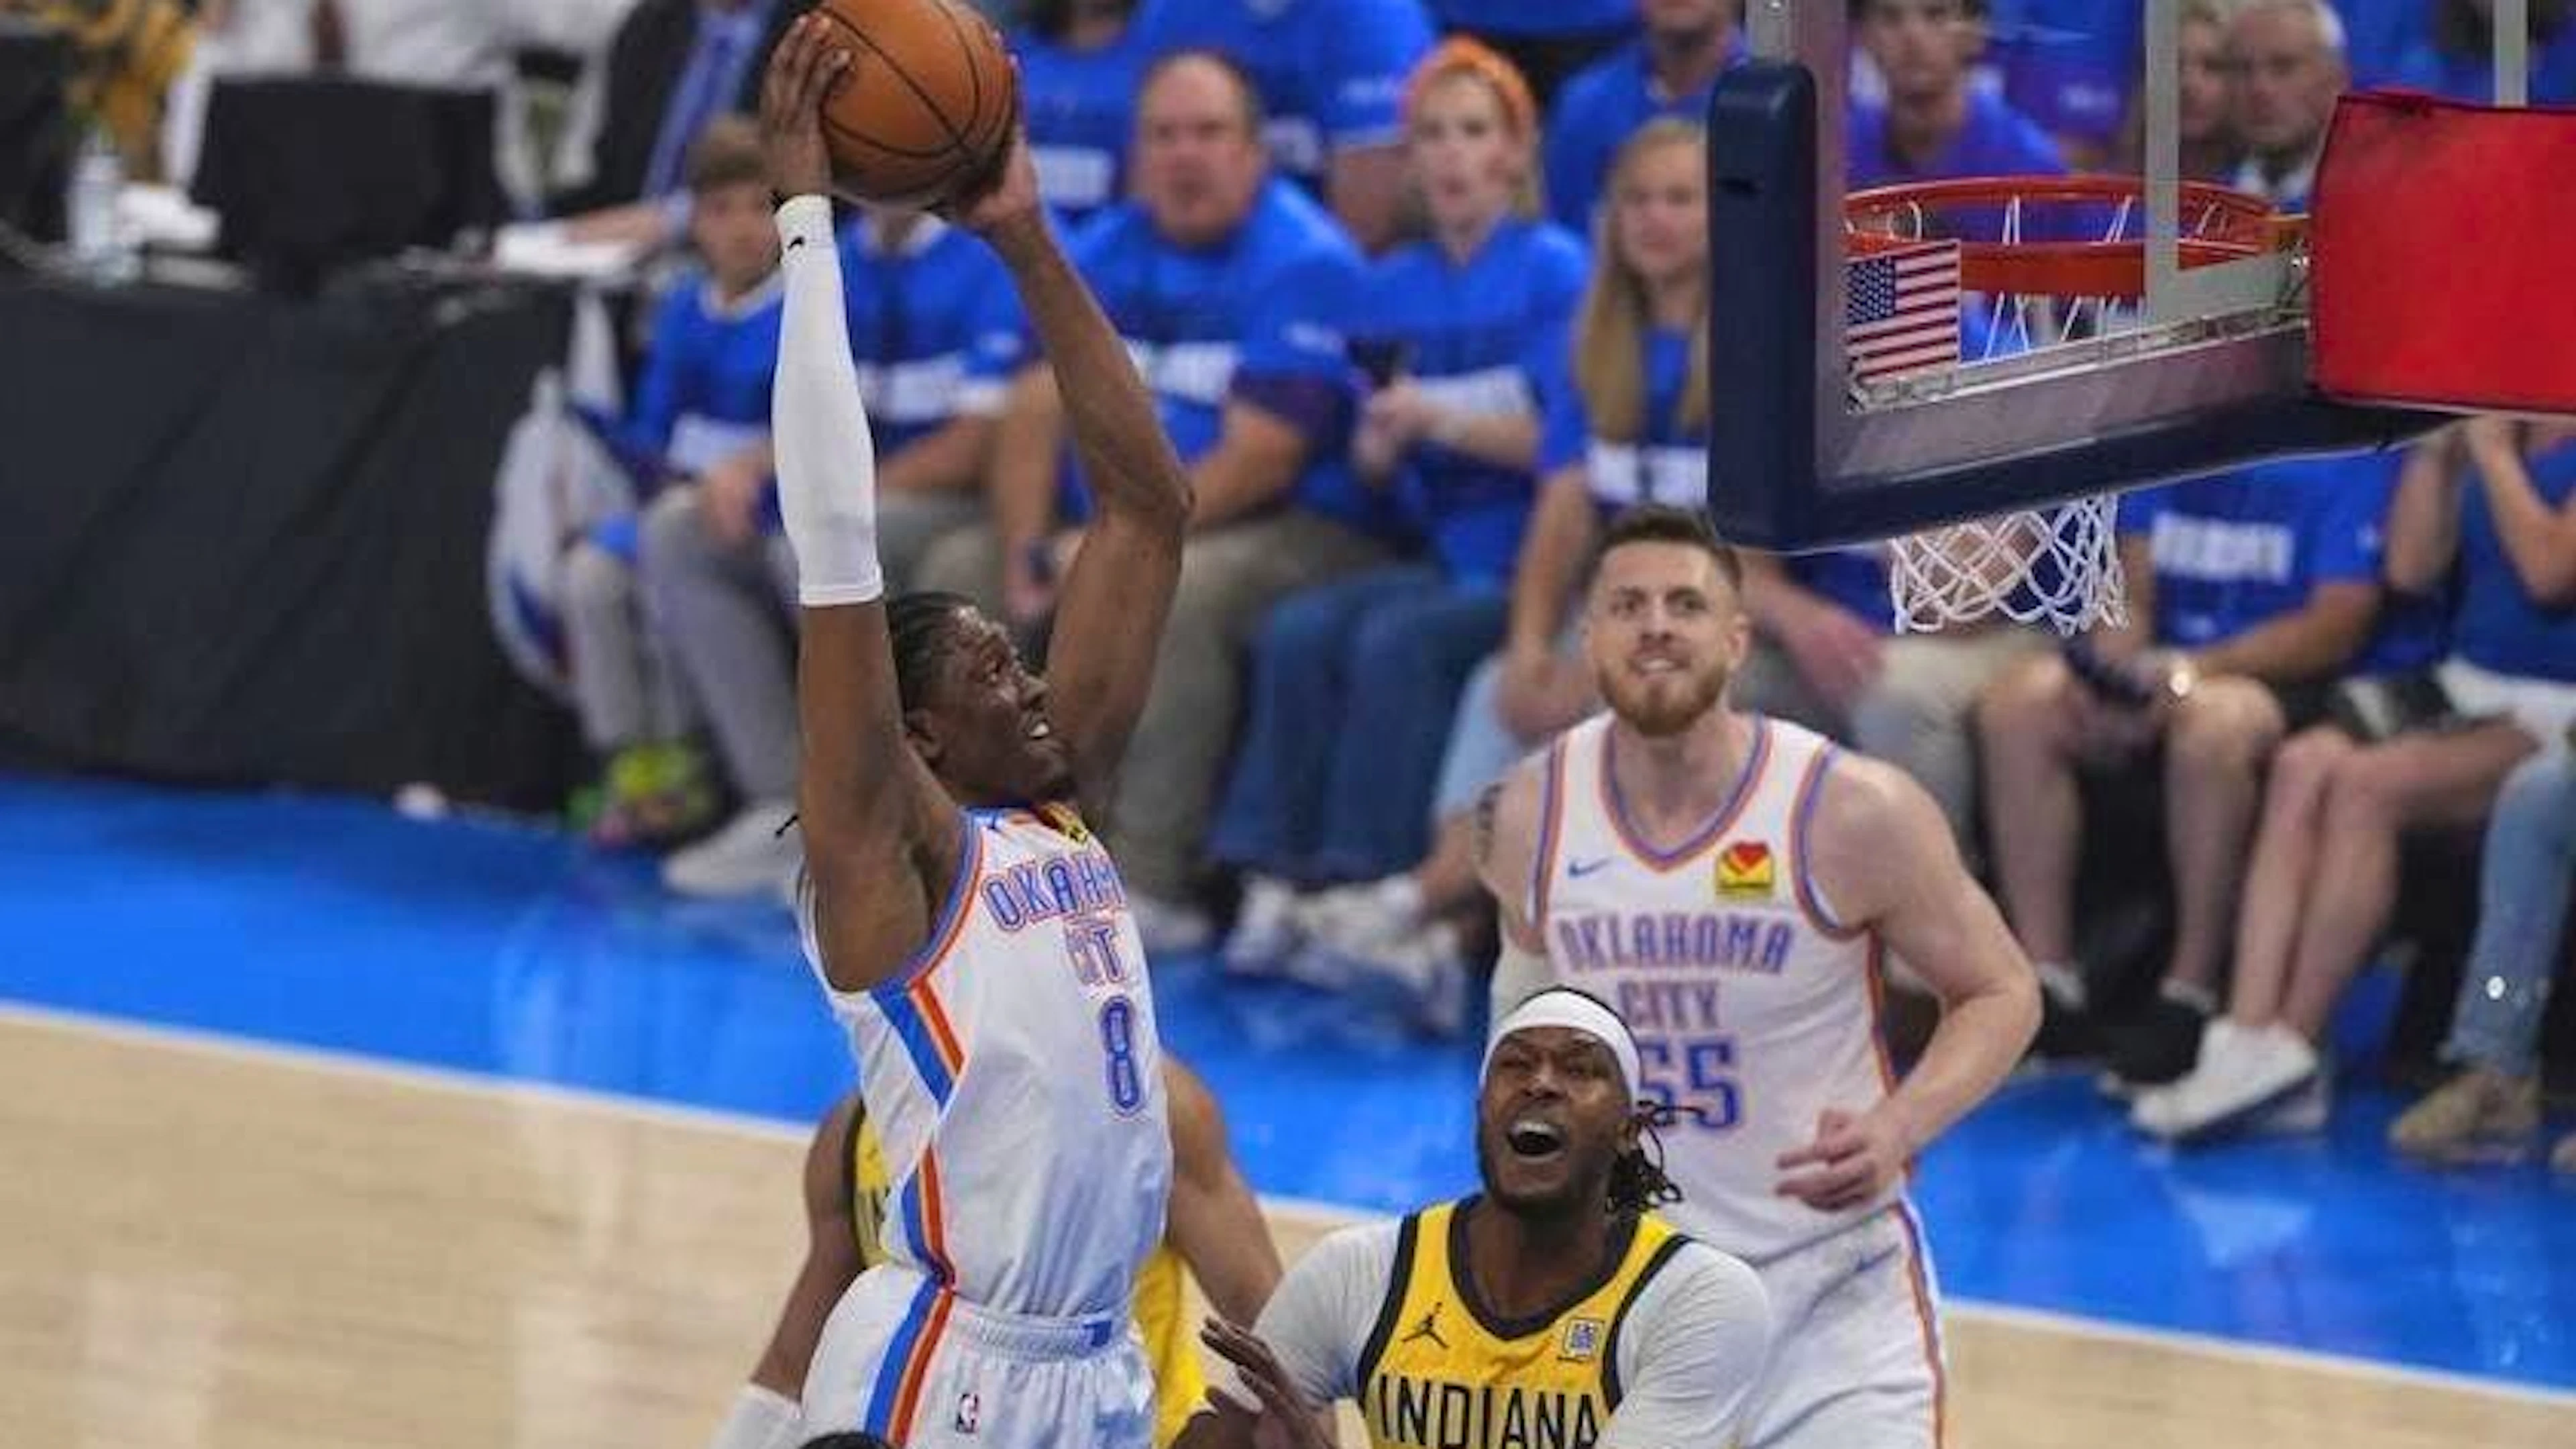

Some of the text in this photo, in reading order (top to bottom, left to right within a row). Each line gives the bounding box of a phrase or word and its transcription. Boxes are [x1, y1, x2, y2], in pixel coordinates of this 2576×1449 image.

[1557, 912, 1794, 975] OKLAHOMA
[1617, 981, 1720, 1030] CITY
[1098, 996, 1143, 1115] 8
[1379, 1373, 1599, 1449] INDIANA
